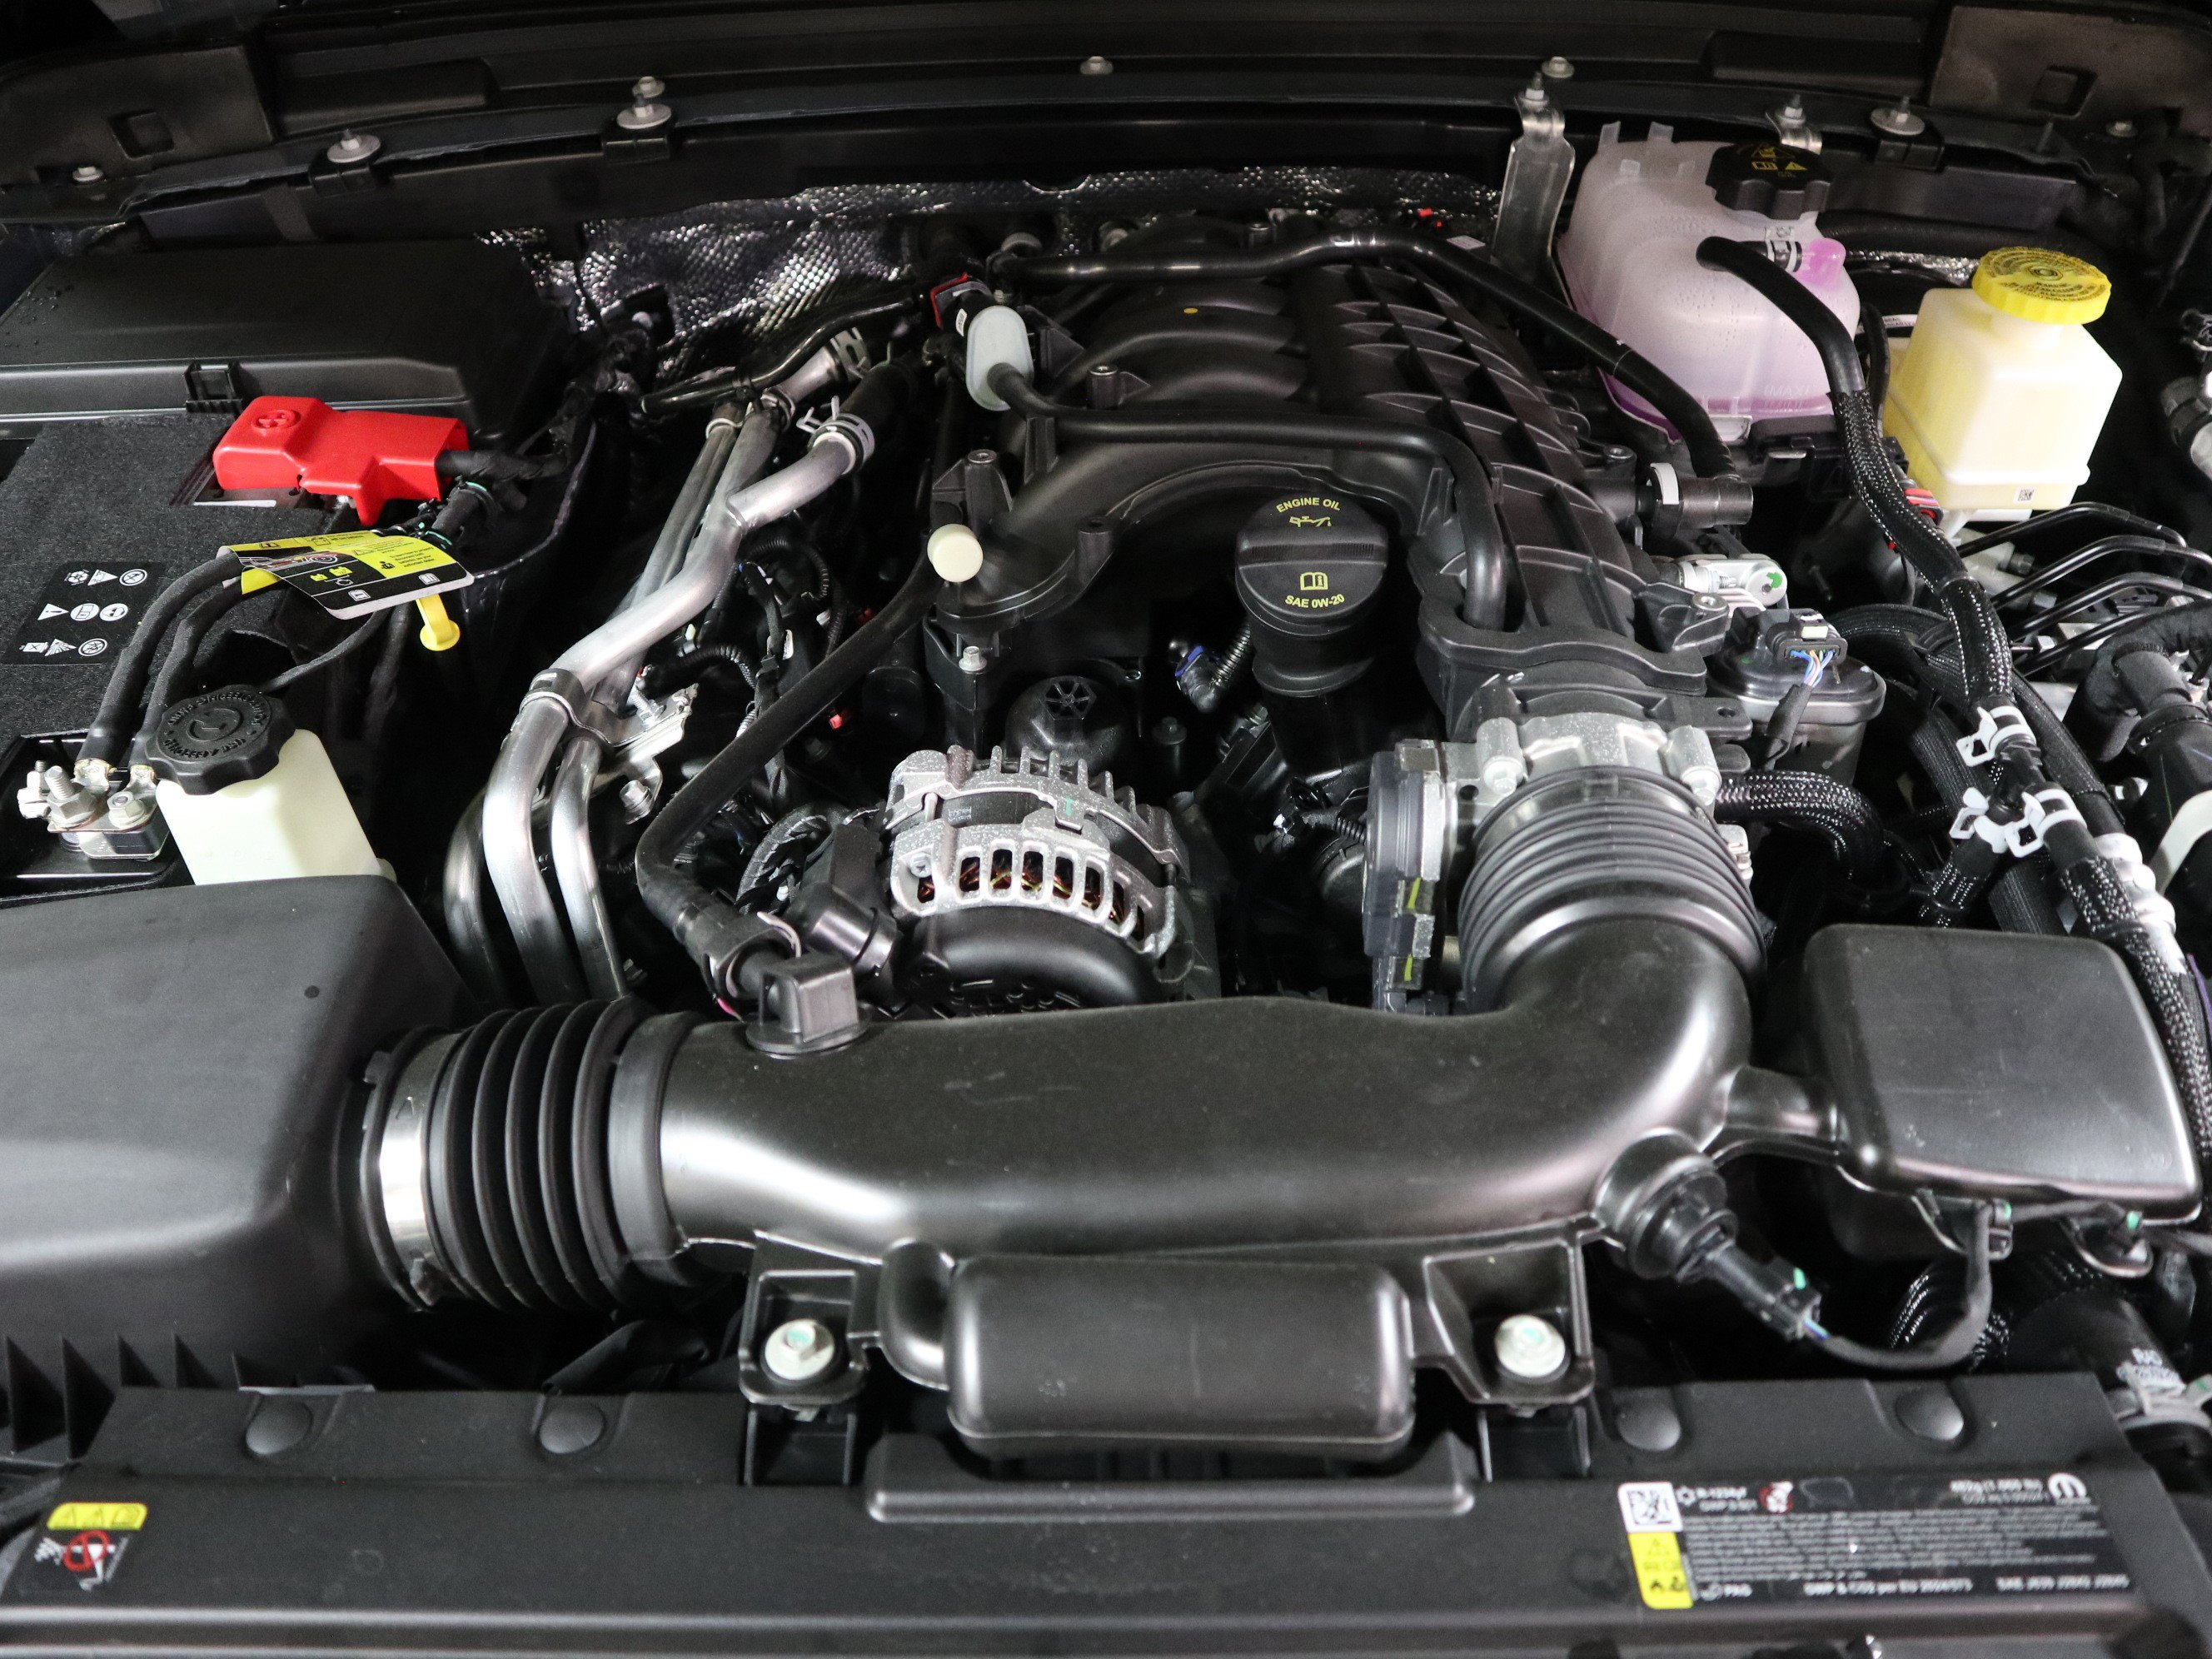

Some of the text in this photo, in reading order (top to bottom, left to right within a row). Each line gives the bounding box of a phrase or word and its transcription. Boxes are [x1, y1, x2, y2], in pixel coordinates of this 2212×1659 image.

[1275, 497, 1341, 513] ENGINE OIL
[1285, 594, 1345, 608] SAE 0W-20
